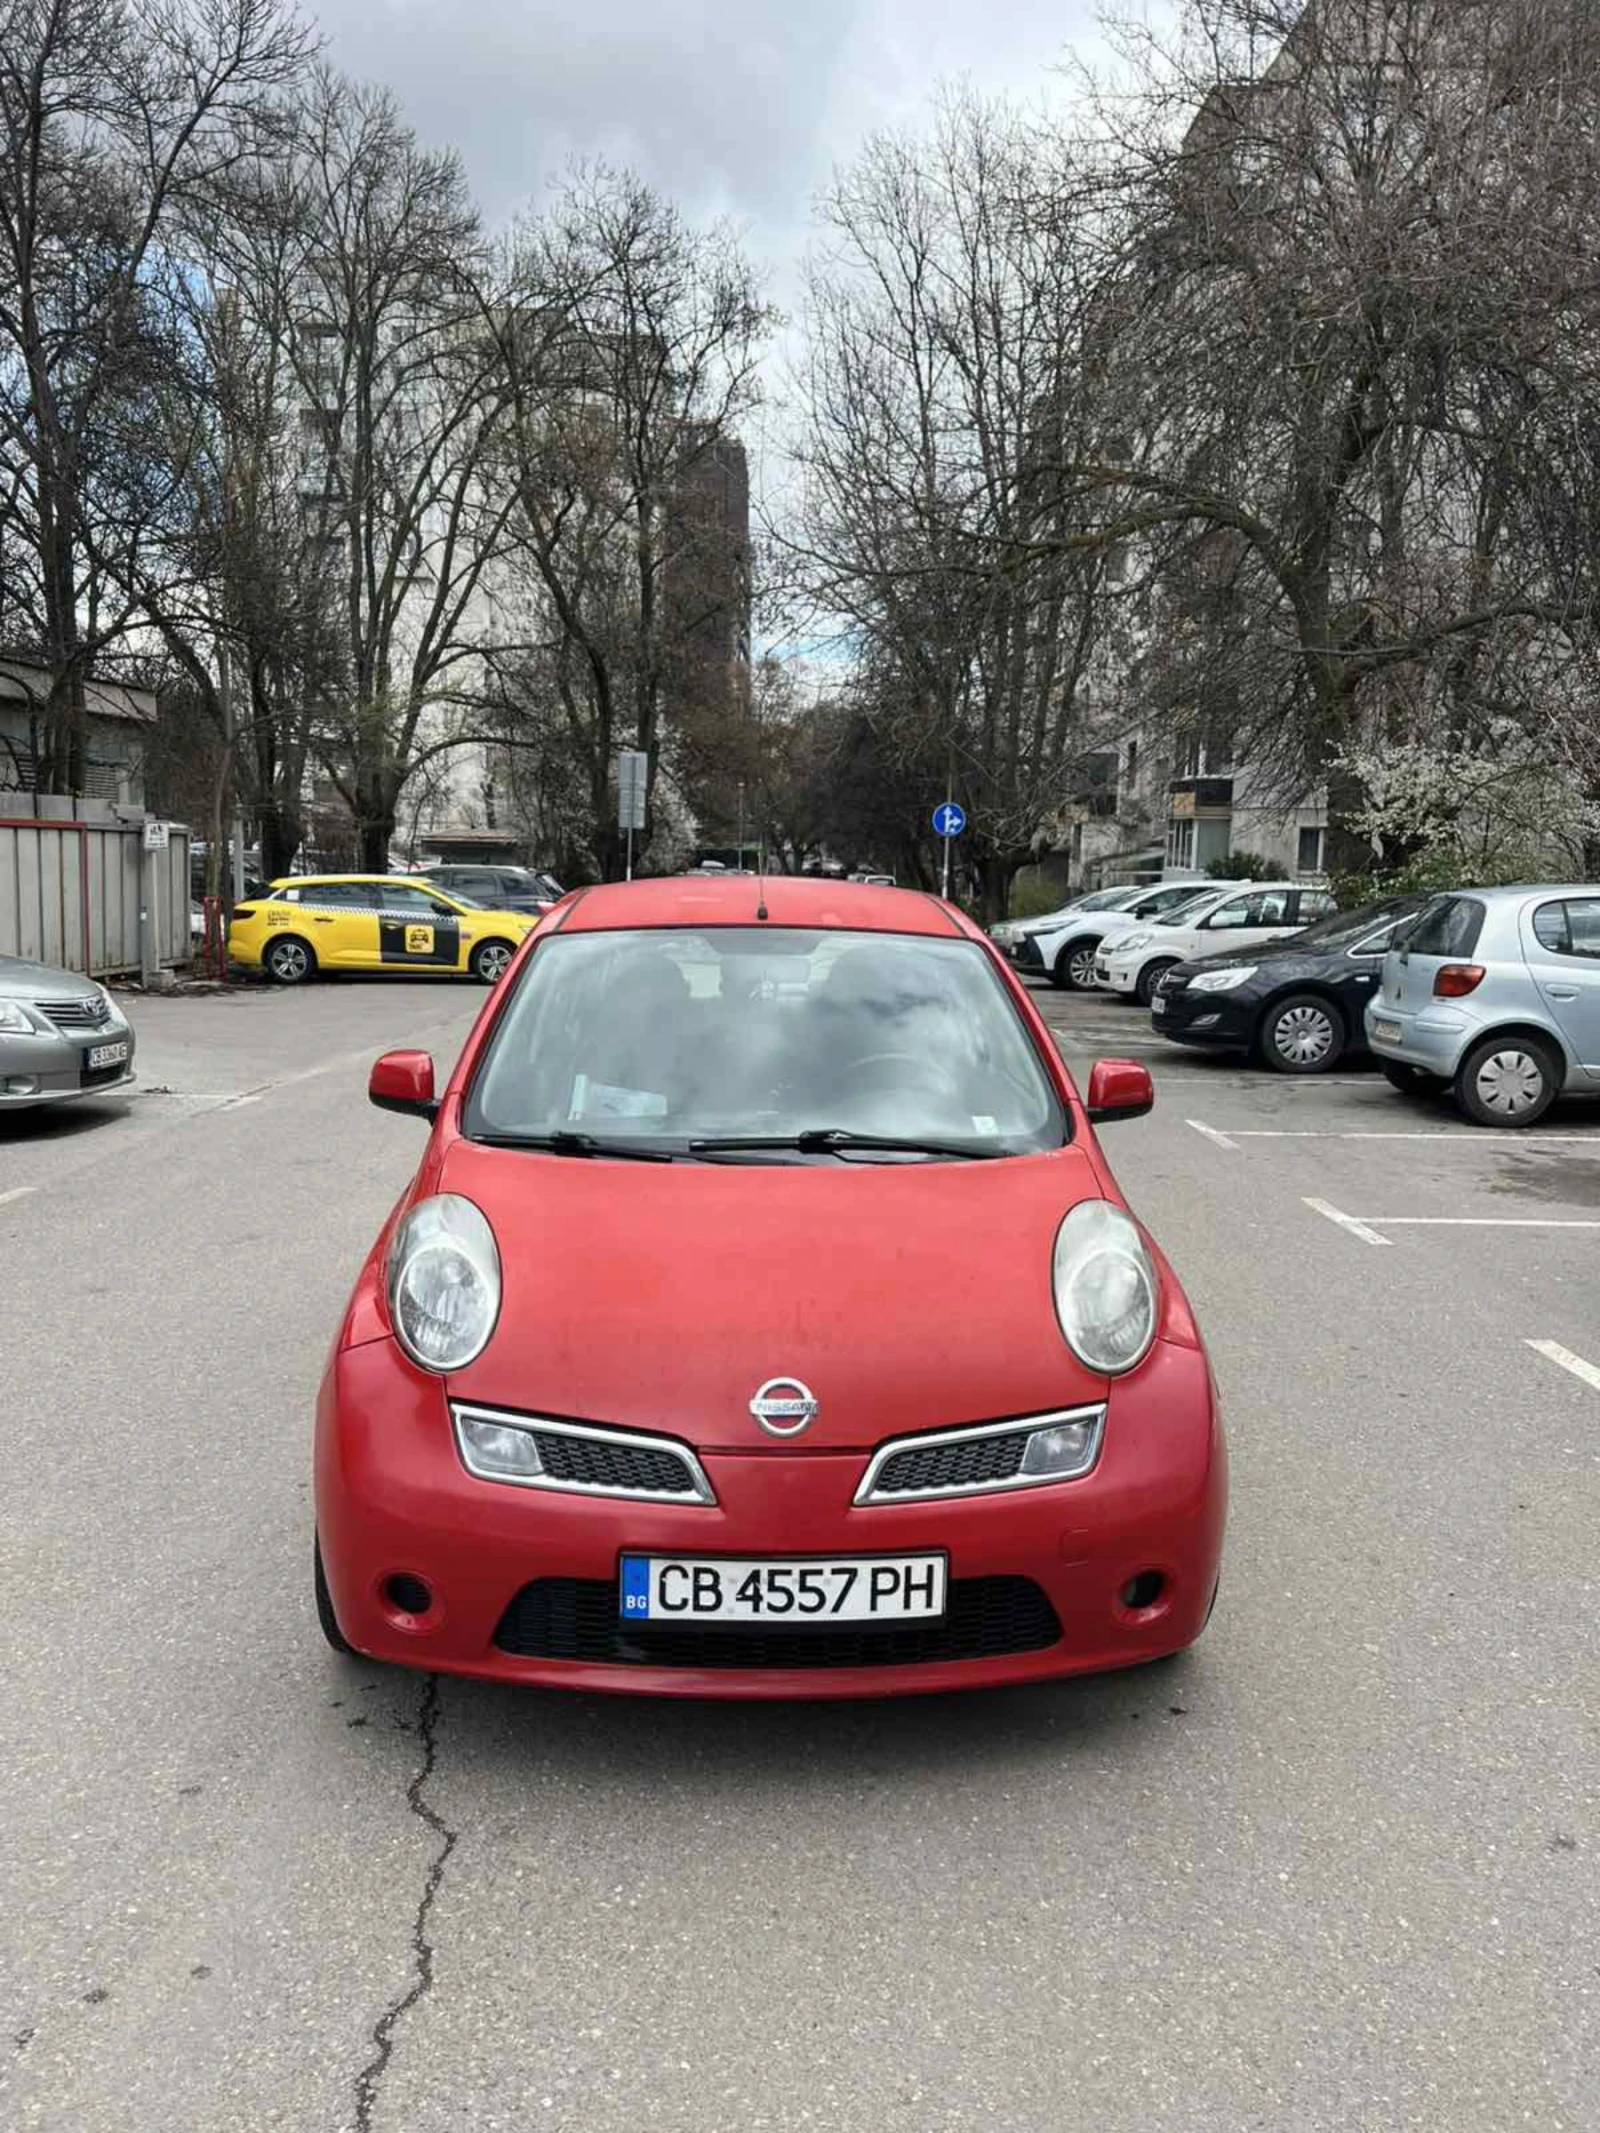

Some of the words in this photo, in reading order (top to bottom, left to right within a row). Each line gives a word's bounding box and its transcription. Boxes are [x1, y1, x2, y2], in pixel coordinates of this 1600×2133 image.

[756, 1402, 813, 1412] NISSAN
[659, 1564, 724, 1612] CB
[735, 1567, 859, 1614] 4557
[870, 1564, 935, 1612] PH
[626, 1595, 647, 1609] BG
